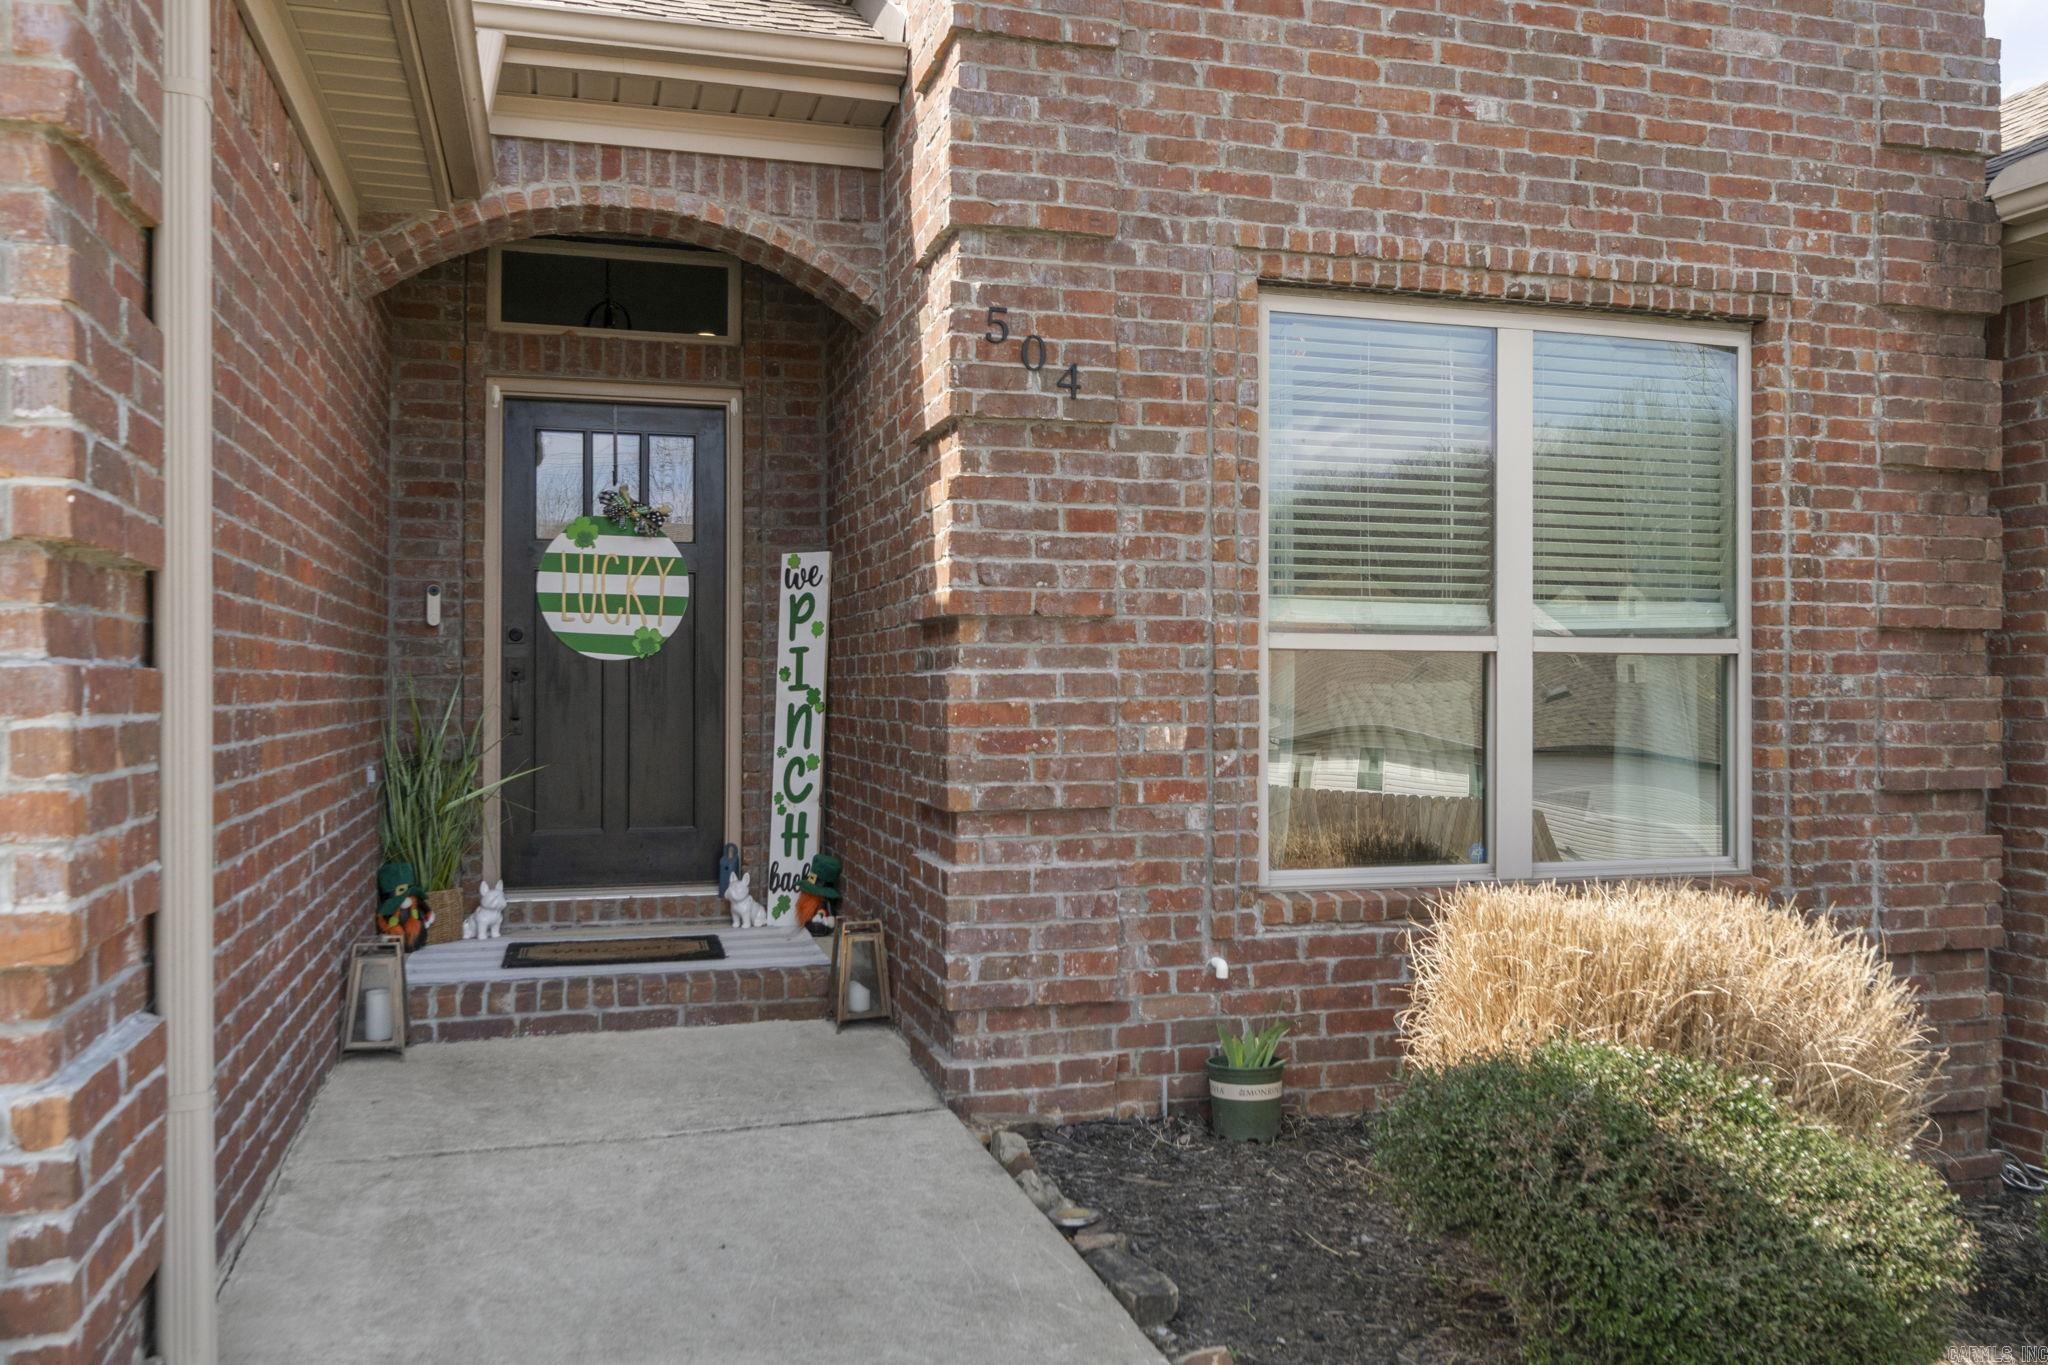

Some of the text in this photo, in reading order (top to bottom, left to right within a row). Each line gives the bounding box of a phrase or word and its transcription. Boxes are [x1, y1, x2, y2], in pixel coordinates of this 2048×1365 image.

[985, 306, 1081, 400] 504
[561, 550, 675, 627] LUCKY
[784, 565, 823, 590] we
